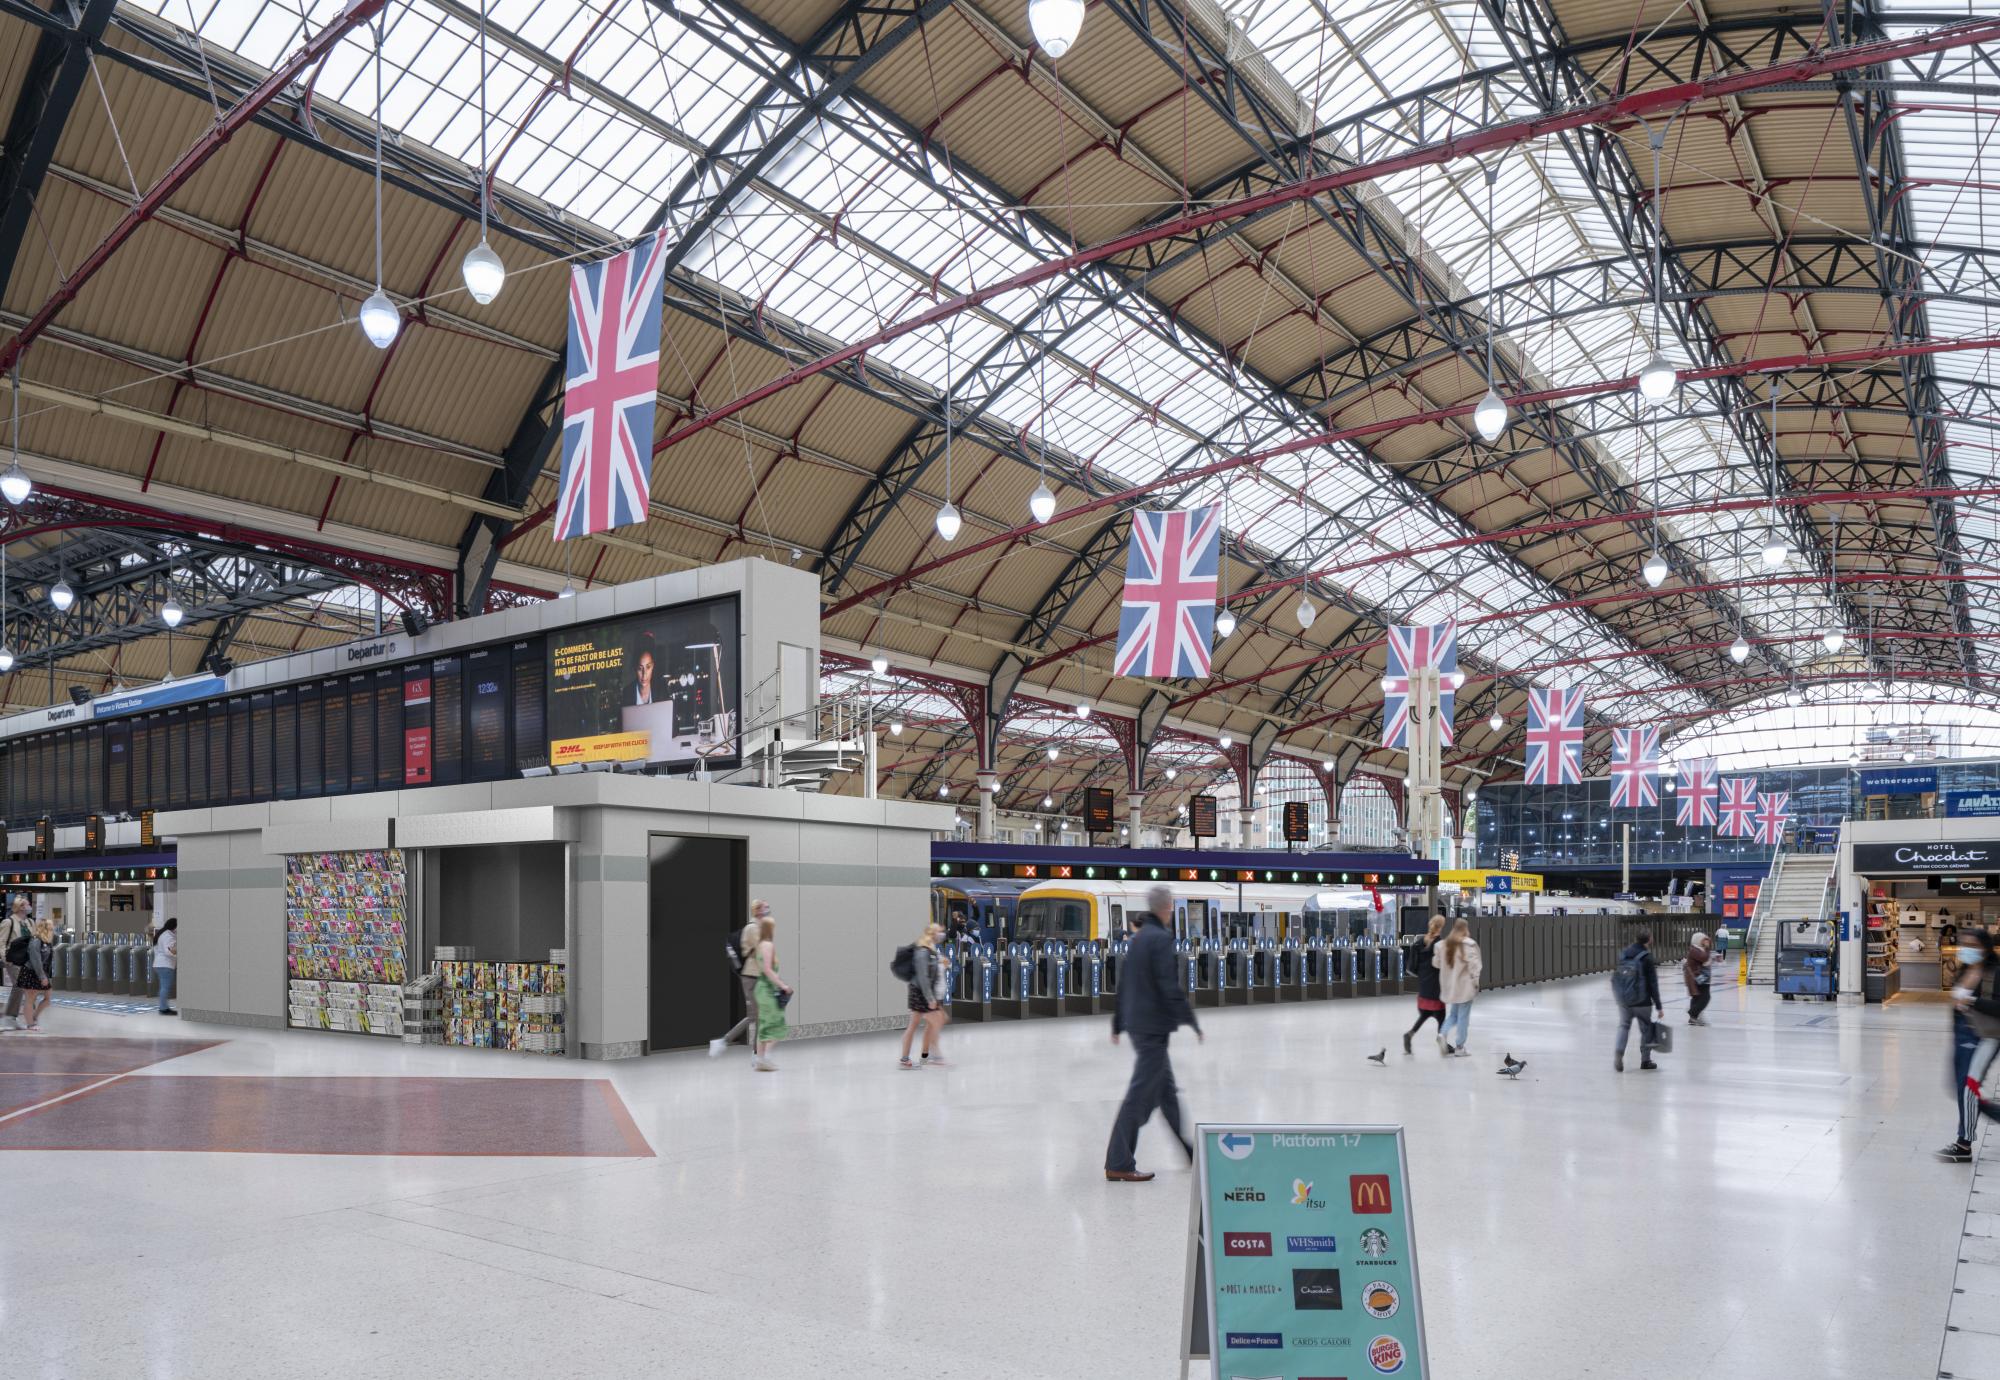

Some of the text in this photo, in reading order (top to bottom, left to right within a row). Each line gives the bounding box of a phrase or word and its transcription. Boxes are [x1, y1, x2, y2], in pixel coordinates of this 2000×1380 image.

[555, 642, 594, 657] E-COMMERCE.
[555, 648, 624, 667] IT'S BE FAST OR BE LAST.
[555, 658, 623, 677] AND WE DON'T DO LAST.
[128, 698, 143, 707] Station
[47, 707, 76, 722] Departures
[560, 744, 583, 754] DHL
[1866, 776, 1932, 785] wetherspoon
[1272, 1133, 1361, 1148] Platform 1-7
[1224, 1192, 1266, 1202] NERO
[1306, 1198, 1326, 1209] itsu
[1230, 1239, 1265, 1249] COSTA
[1288, 1237, 1334, 1247] WHSmith
[1226, 1284, 1276, 1294] PRET A MANGER
[1372, 1282, 1394, 1293] PASTY
[1231, 1336, 1250, 1344] Delice
[1256, 1336, 1279, 1344] France
[1292, 1338, 1352, 1346] CARDS GALORE
[1372, 1342, 1399, 1356] BURGER
[1373, 1349, 1401, 1366] KING
